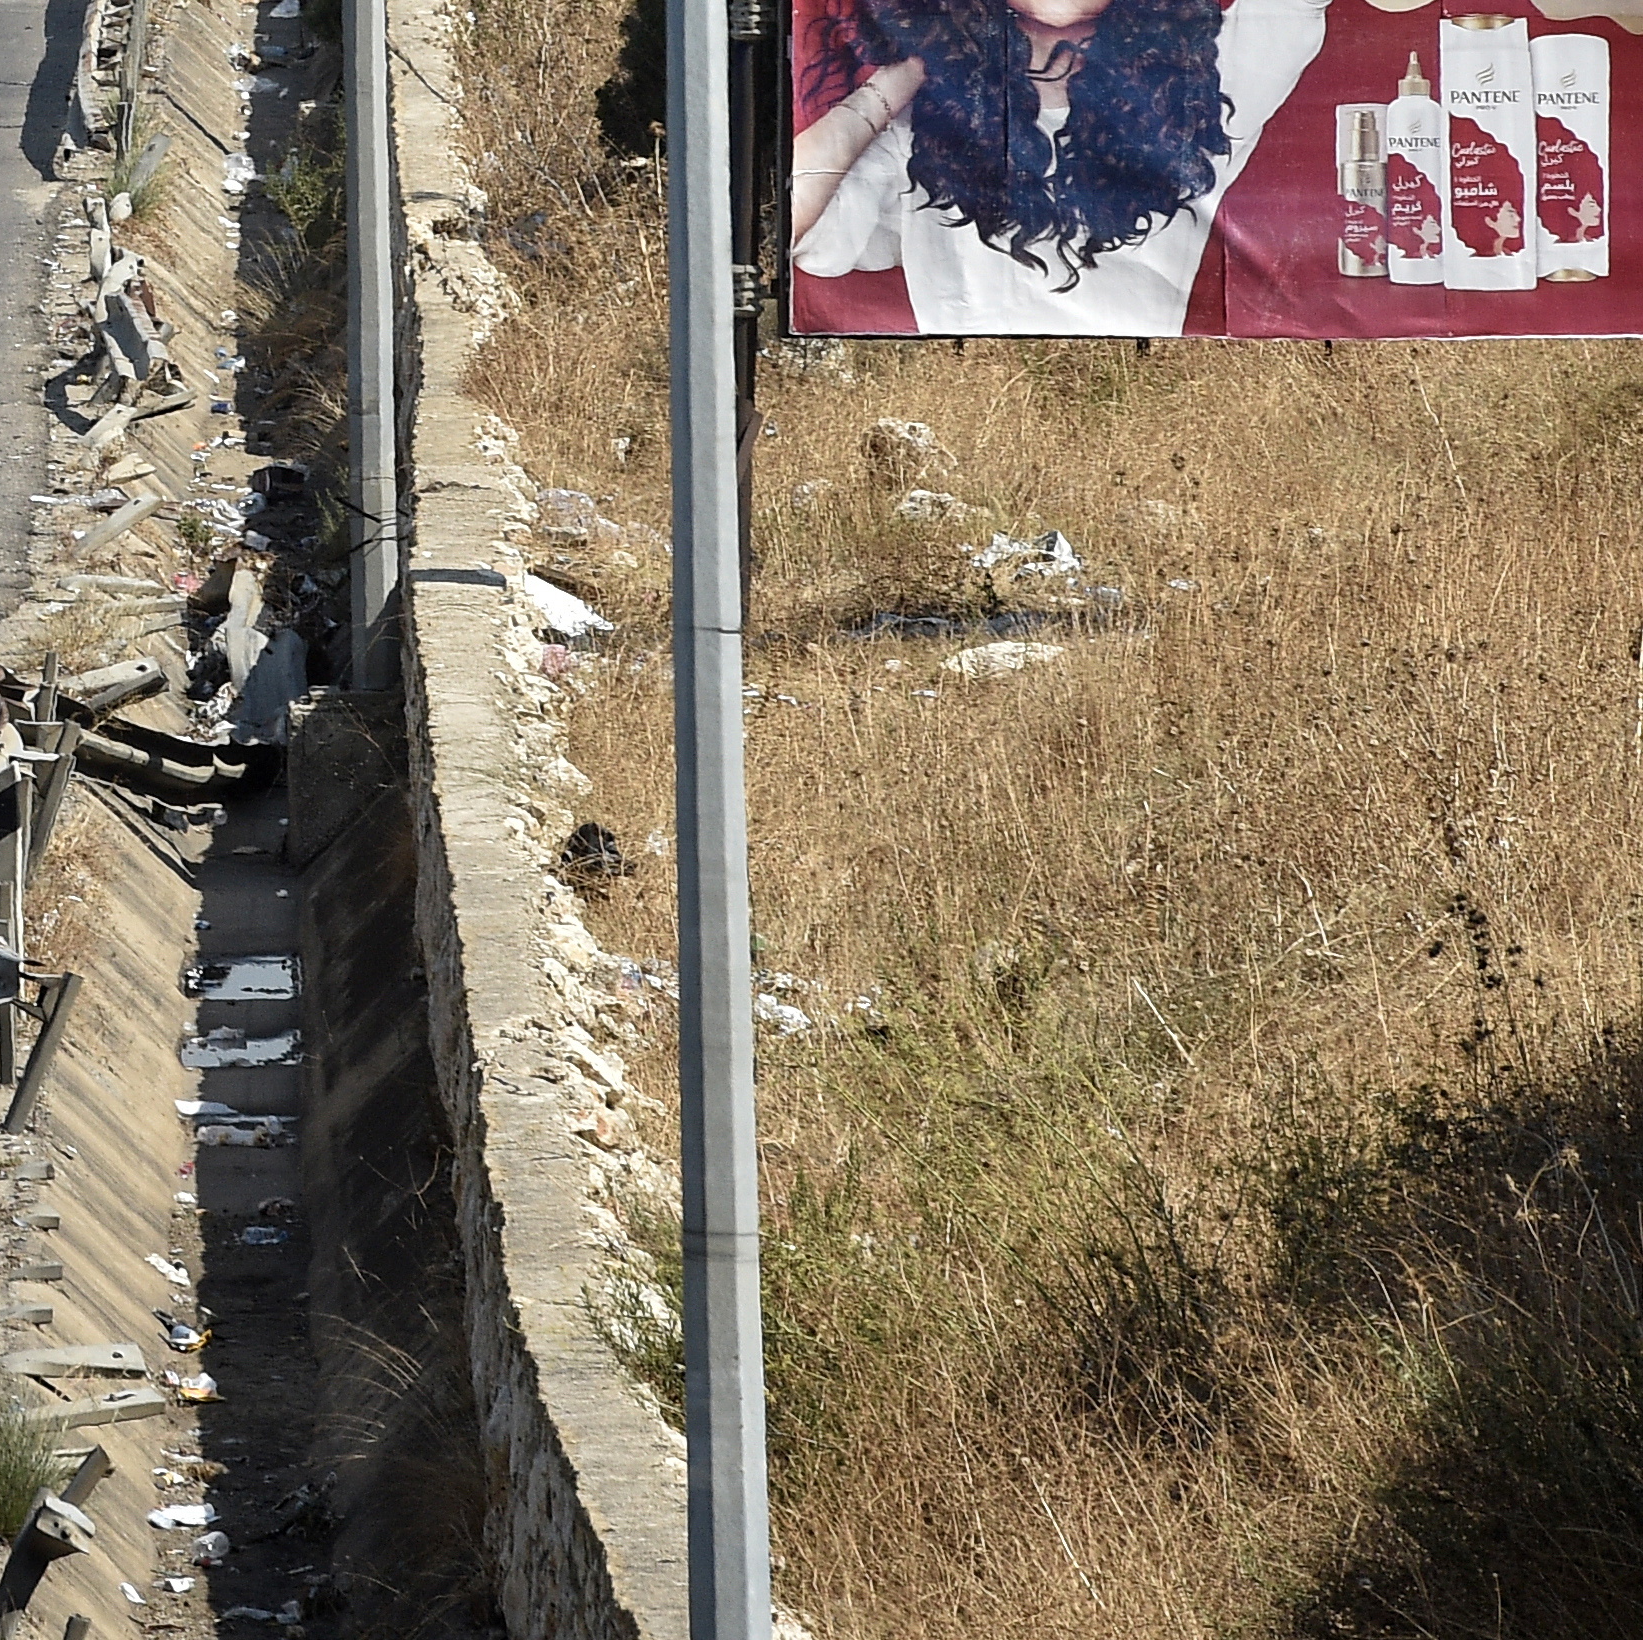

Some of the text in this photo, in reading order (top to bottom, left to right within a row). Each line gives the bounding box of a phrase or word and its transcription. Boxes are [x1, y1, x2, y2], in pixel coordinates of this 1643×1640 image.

[1450, 90, 1521, 104] PANTENE
[1537, 92, 1600, 105] PANTENE
[1388, 137, 1441, 148] PANTENE
[1454, 183, 1498, 198] شامبو
